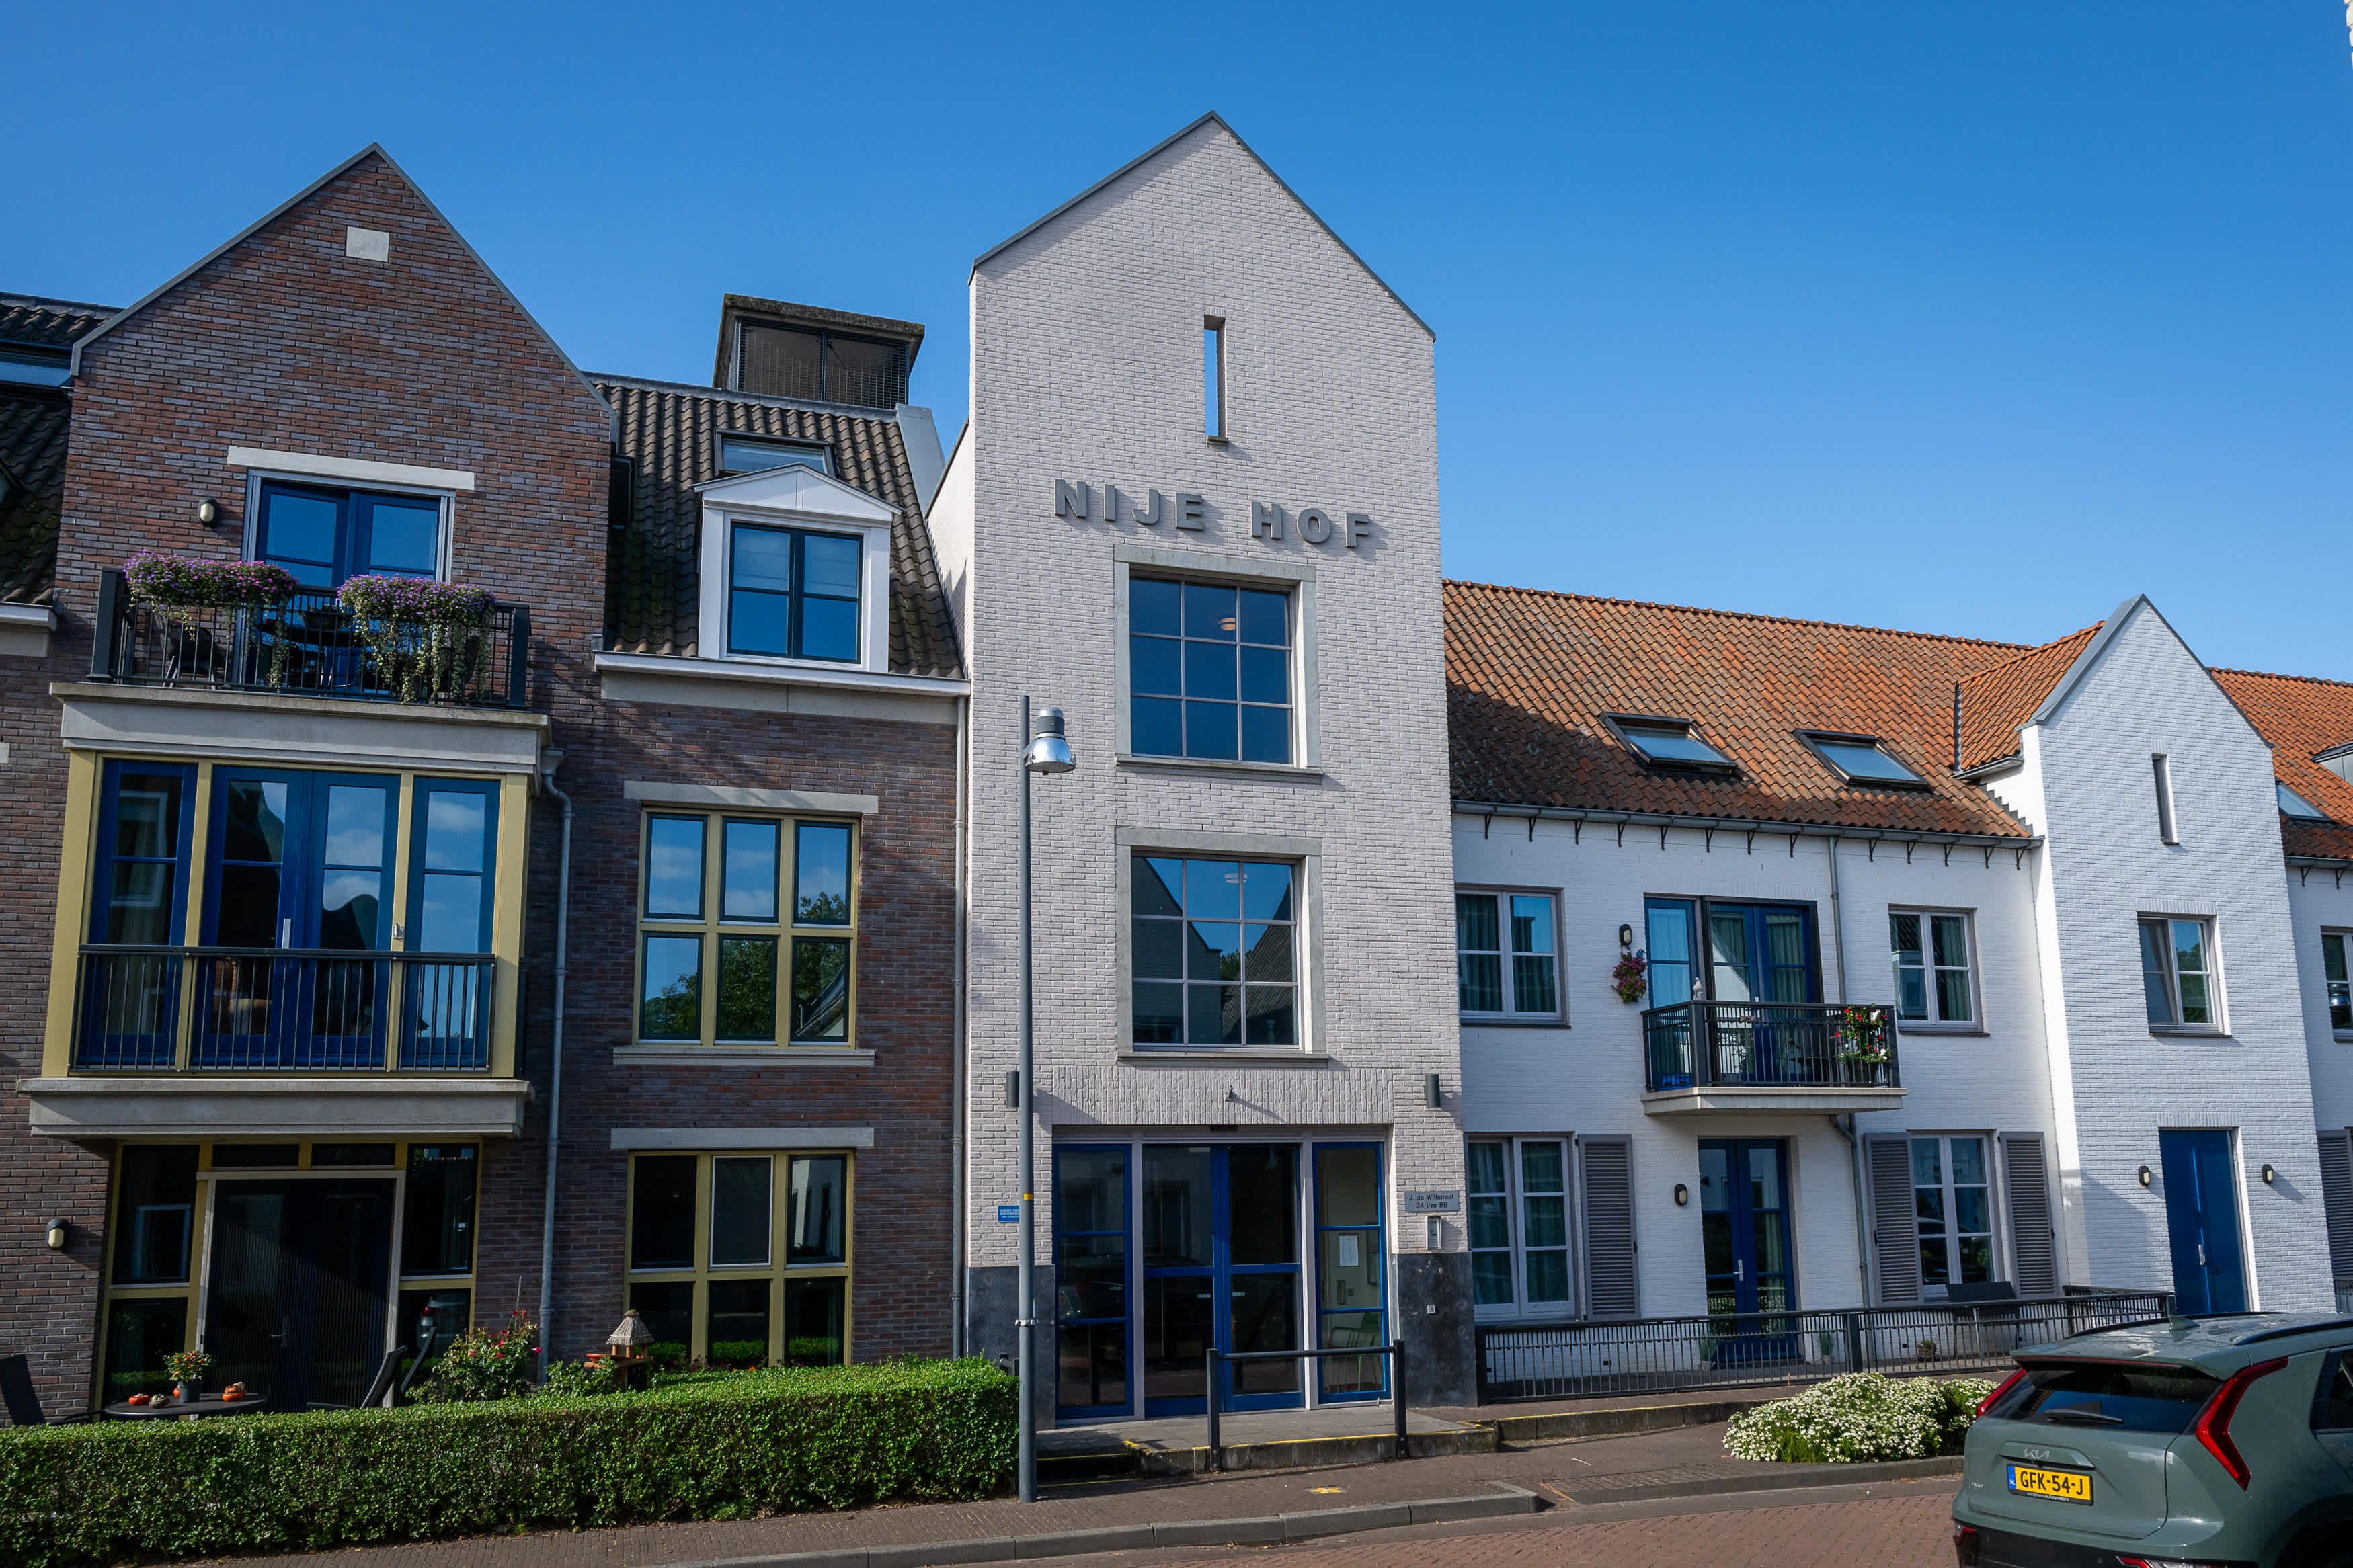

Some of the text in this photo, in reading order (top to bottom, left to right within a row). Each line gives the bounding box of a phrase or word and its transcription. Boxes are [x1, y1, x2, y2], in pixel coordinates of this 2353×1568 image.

[1054, 478, 1370, 549] NIJE HOF
[2020, 1471, 2083, 1495] GFK-54-J
